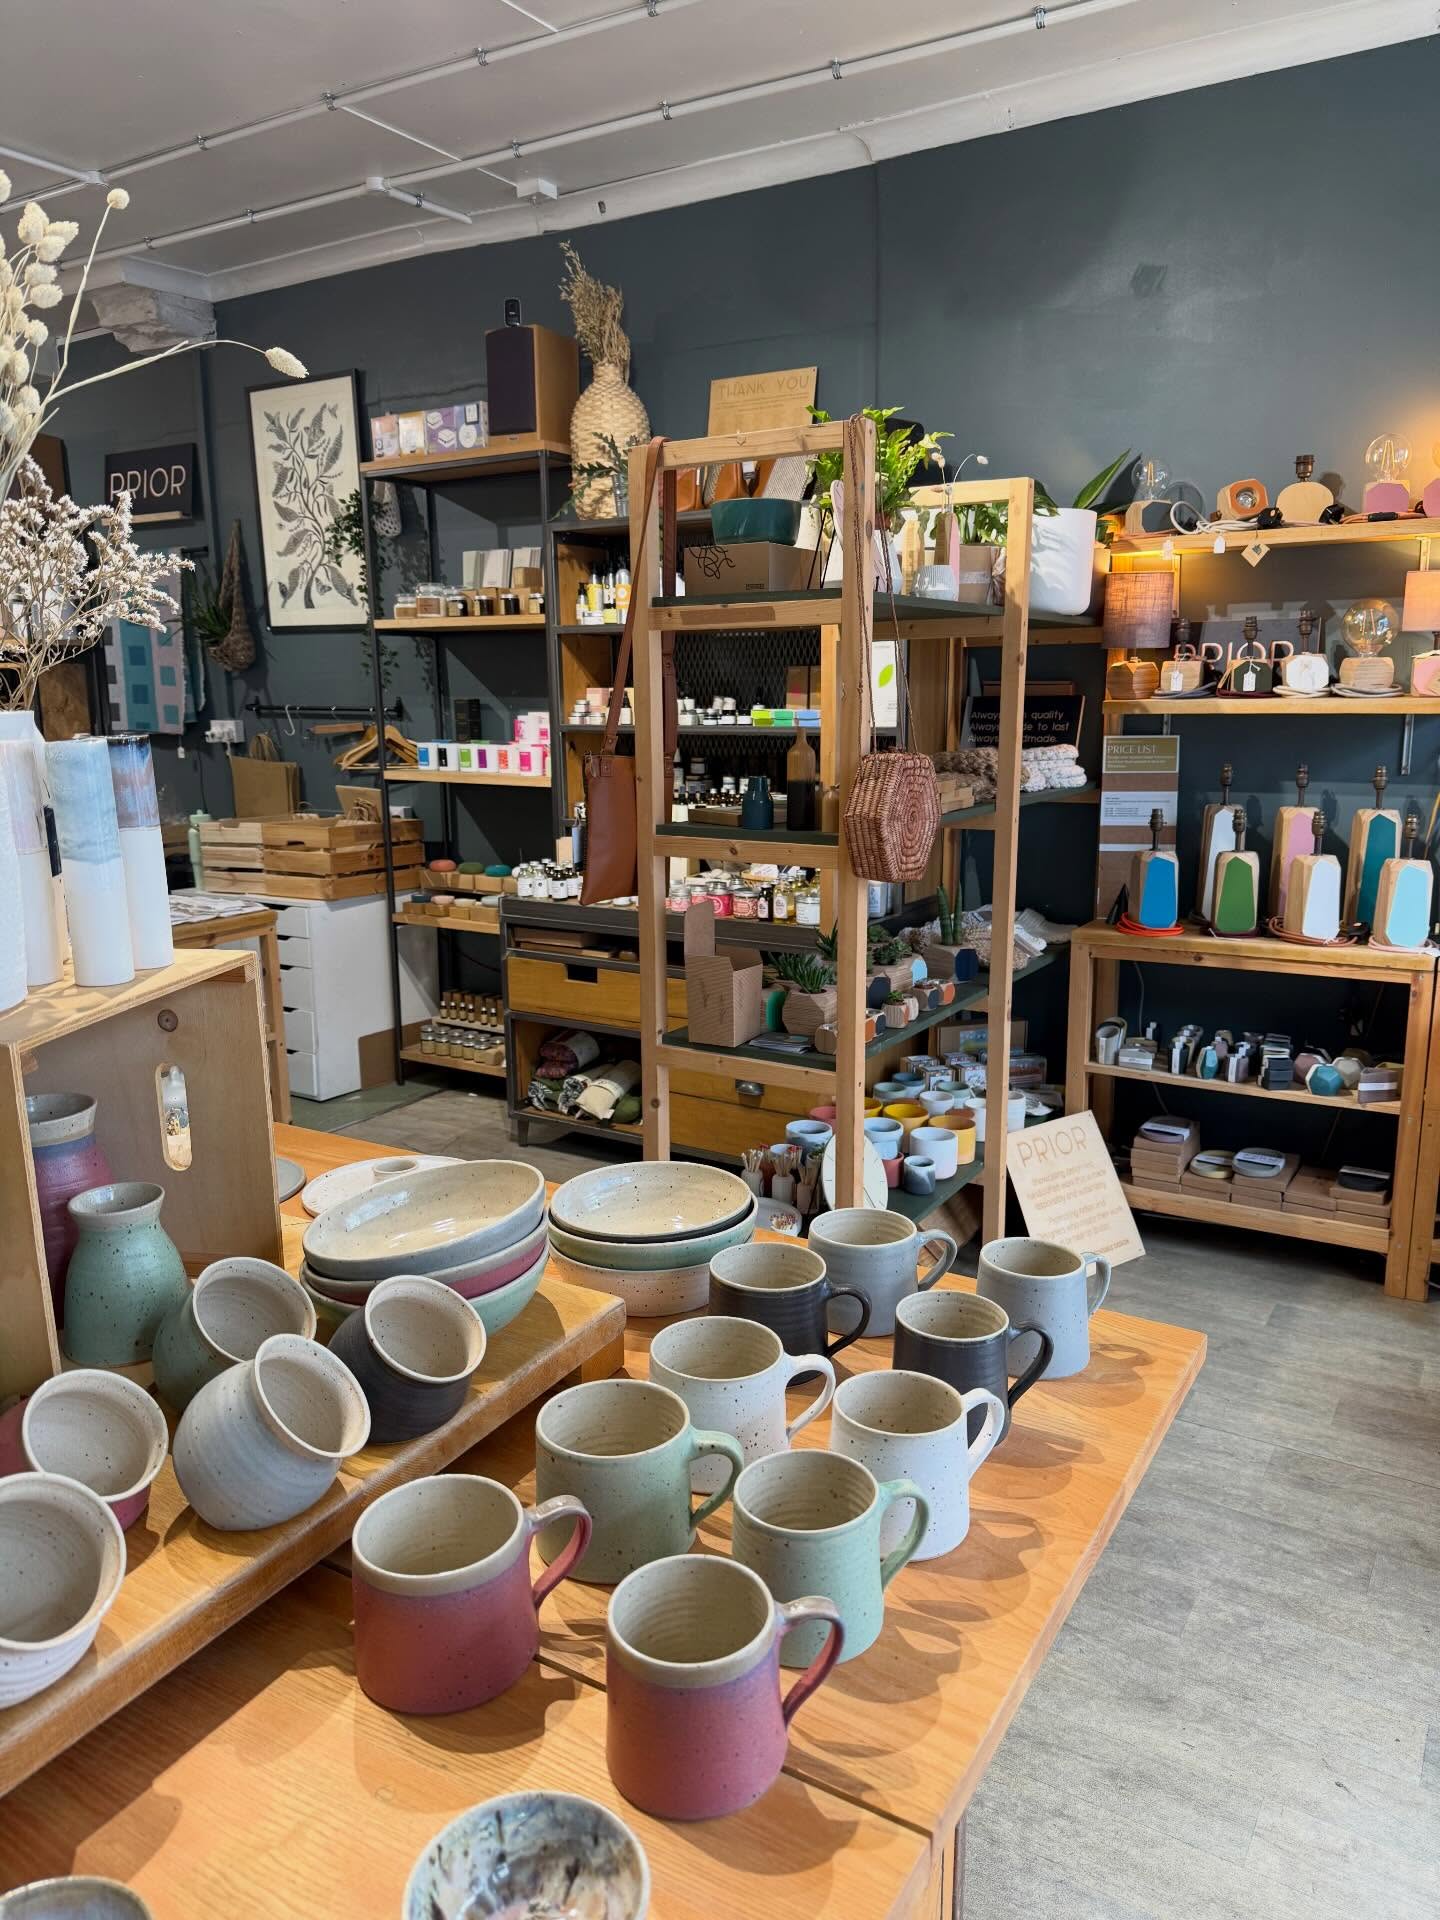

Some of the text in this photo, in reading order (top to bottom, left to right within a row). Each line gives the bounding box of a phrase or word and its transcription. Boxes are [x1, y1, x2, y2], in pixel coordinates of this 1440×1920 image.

[718, 375, 810, 400] THANK YOU
[110, 465, 186, 502] PRIOR
[971, 711, 1000, 720] Alway
[1031, 710, 1064, 721] quality
[1038, 722, 1048, 731] to
[1052, 721, 1070, 731] last
[1107, 744, 1157, 754] PRICE LIST
[1017, 1126, 1088, 1168] PRIOR
